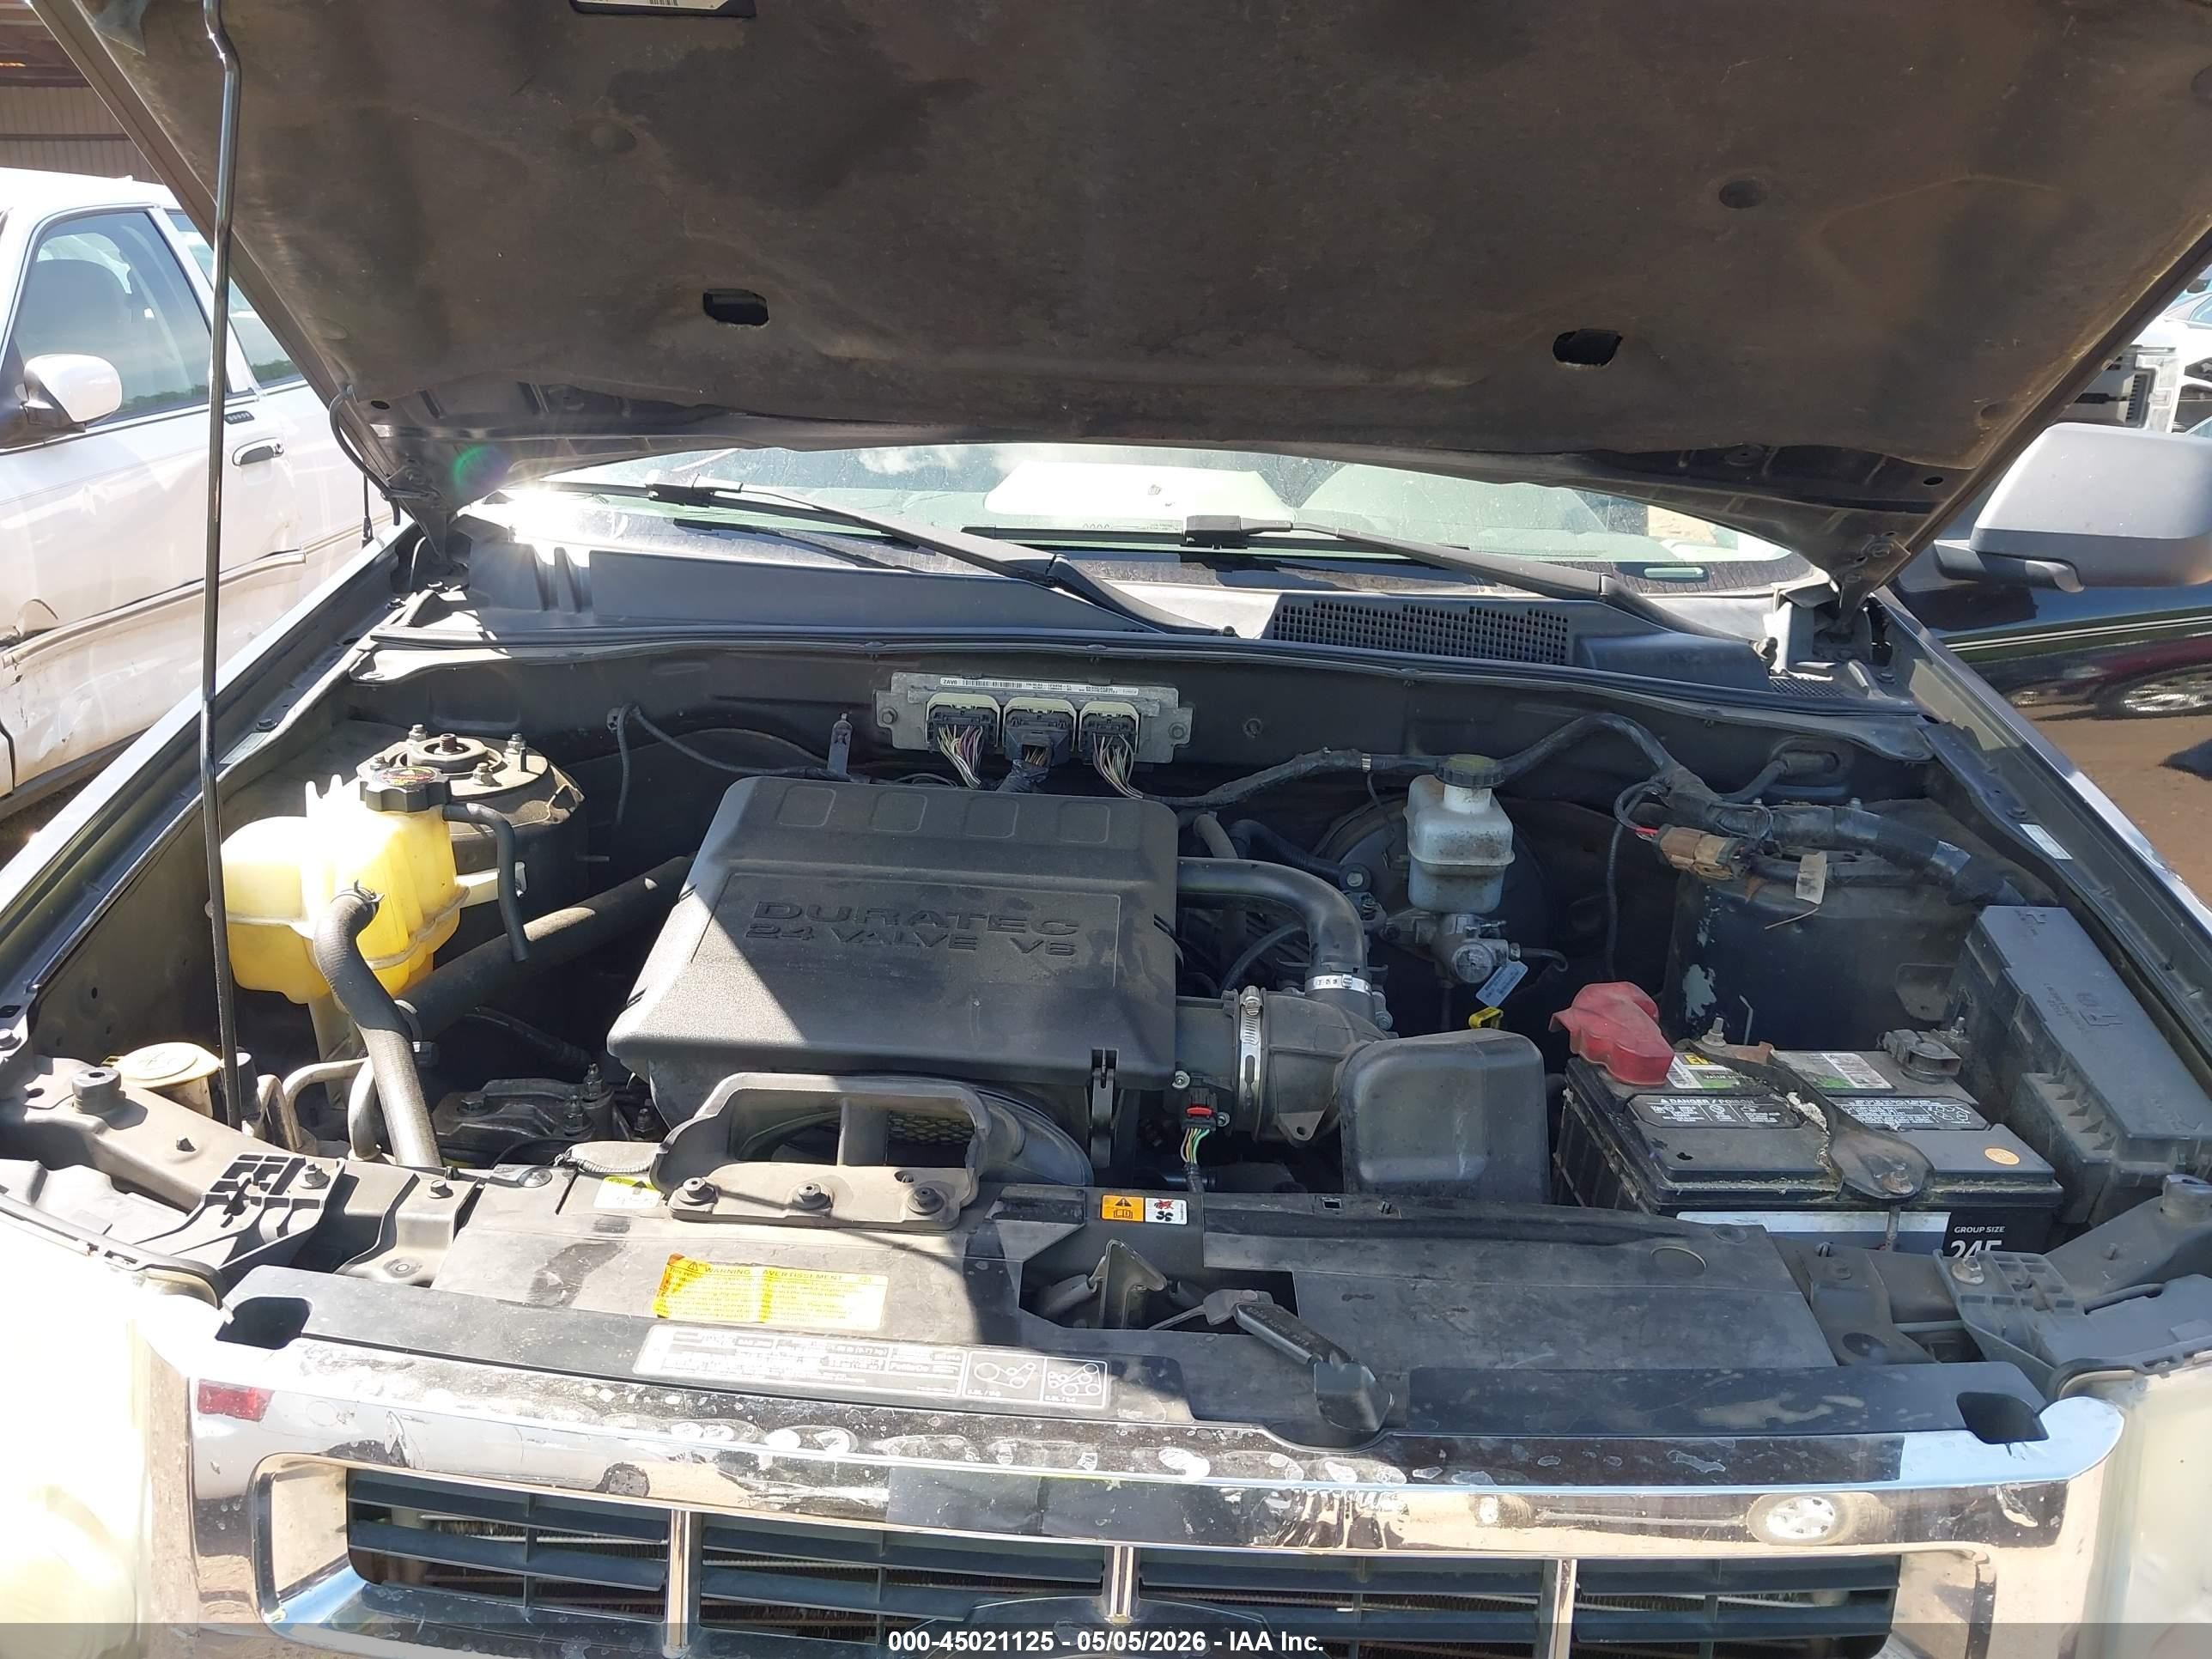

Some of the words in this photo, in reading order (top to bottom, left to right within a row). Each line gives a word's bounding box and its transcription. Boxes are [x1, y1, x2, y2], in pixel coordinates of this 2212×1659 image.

[752, 900, 1079, 937] DURATEC
[745, 923, 814, 941] 24
[830, 928, 978, 951] VALVE
[1011, 936, 1077, 957] V6
[704, 1267, 751, 1275] WARNING
